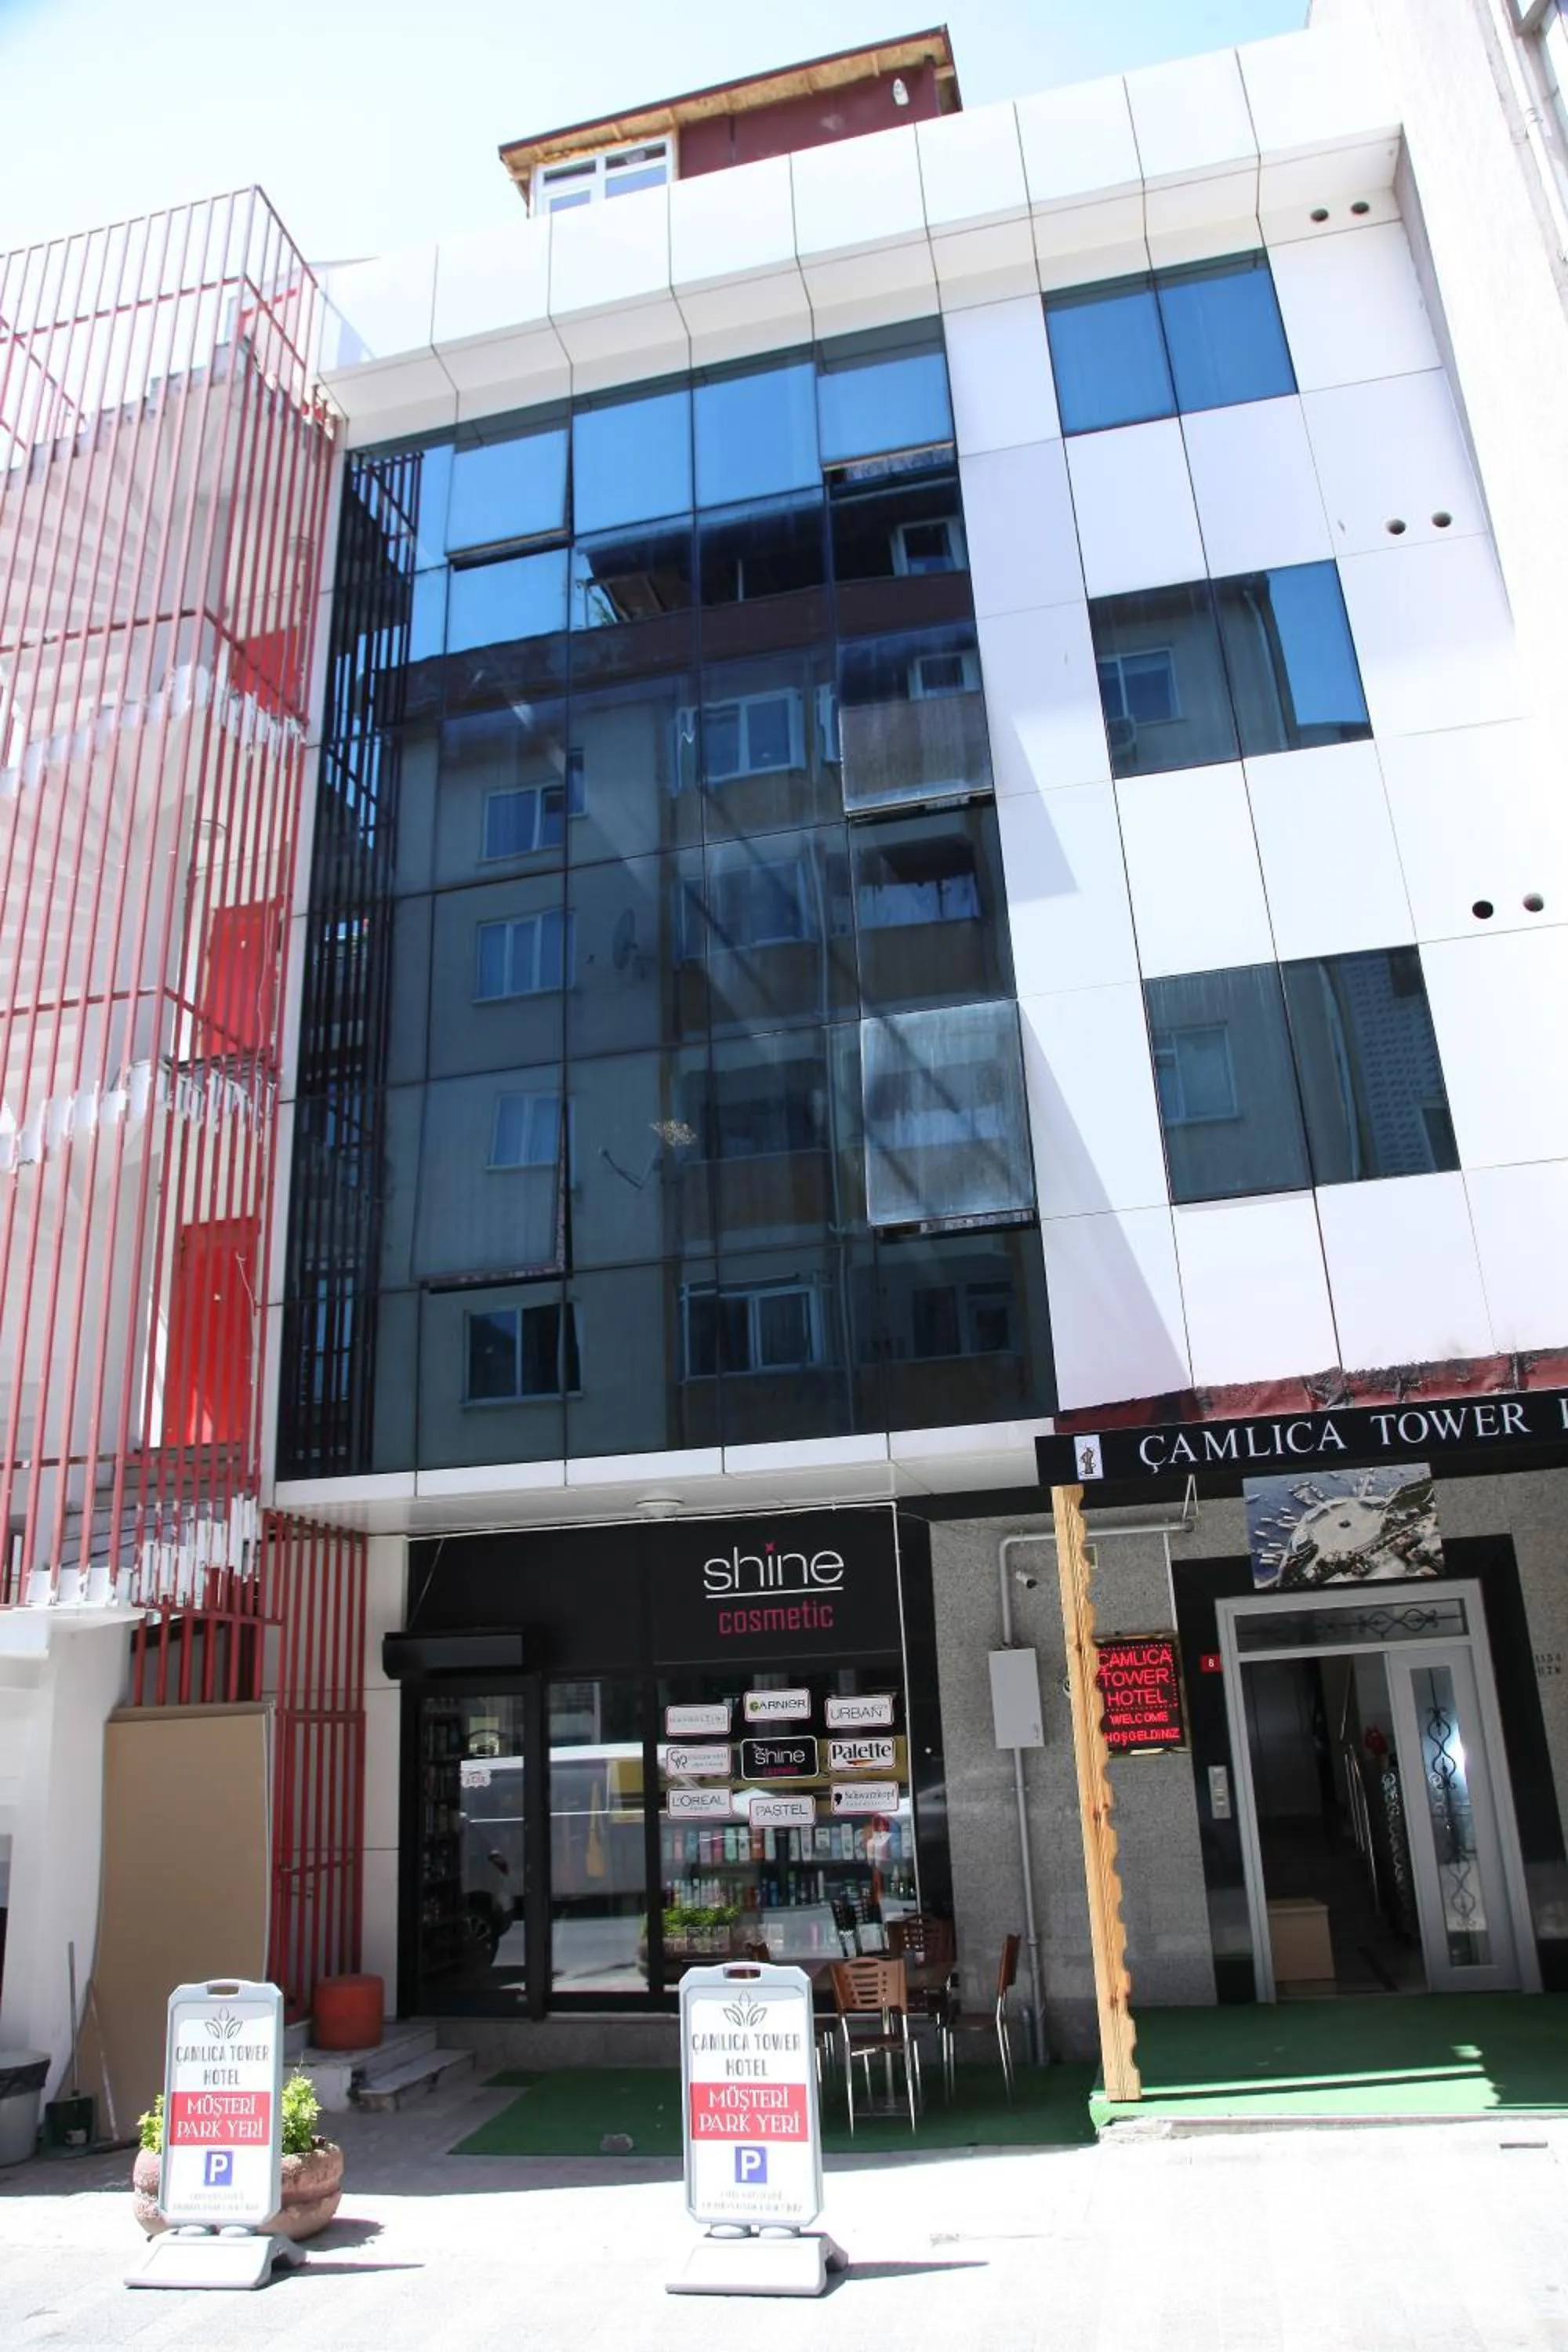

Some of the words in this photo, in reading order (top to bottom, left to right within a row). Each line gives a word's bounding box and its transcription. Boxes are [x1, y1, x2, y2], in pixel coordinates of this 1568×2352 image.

[1139, 1421, 1347, 1472] ÇAMLICA
[1370, 1402, 1533, 1446] TOWER
[703, 1543, 844, 1591] shine
[718, 1600, 834, 1635] cosmetic
[1100, 1668, 1170, 1687] TOWER
[1106, 1687, 1167, 1707] HOTEL
[830, 1706, 882, 1720] URBAN
[754, 1748, 806, 1765] shine
[832, 1742, 891, 1759] Palette
[755, 1804, 808, 1817] PASTEL
[753, 2033, 801, 2051] TOWER
[230, 2045, 270, 2061] TOWER
[204, 2069, 241, 2085] HOTEL
[725, 2058, 769, 2077] HOTEL
[709, 2085, 789, 2111] MÜŞTERİ
[176, 2119, 222, 2138] PARK
[227, 2116, 263, 2138] YERİ
[699, 2113, 750, 2132] PARK
[755, 2111, 800, 2133] YERİ
